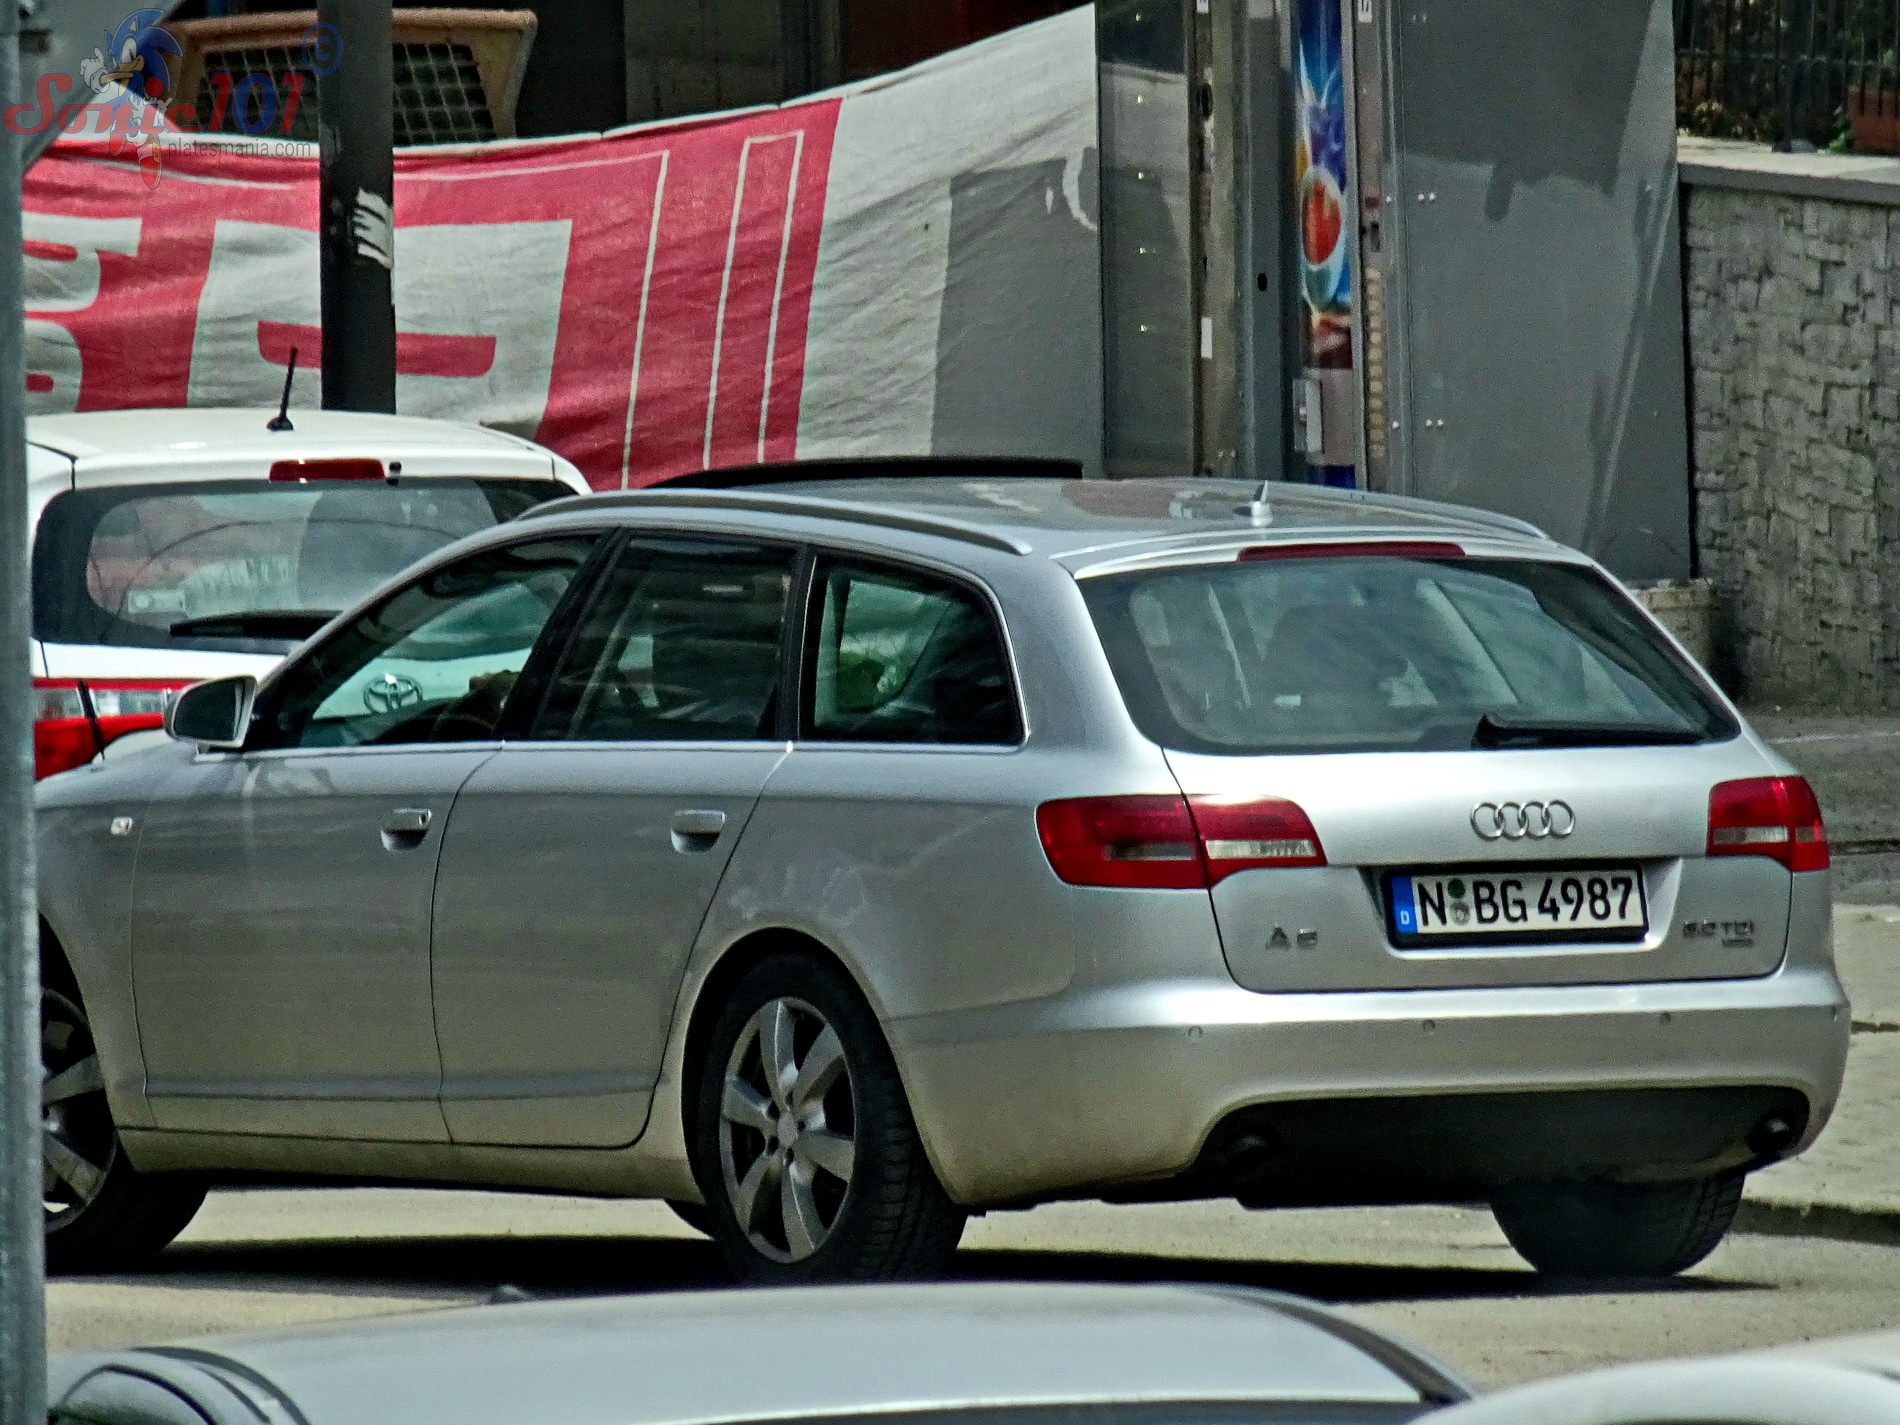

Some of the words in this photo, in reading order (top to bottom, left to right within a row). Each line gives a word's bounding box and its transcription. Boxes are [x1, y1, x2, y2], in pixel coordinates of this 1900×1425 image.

[1417, 881, 1447, 926] N
[1473, 878, 1528, 924] BG
[1537, 876, 1633, 922] 4987
[1399, 910, 1410, 925] D
